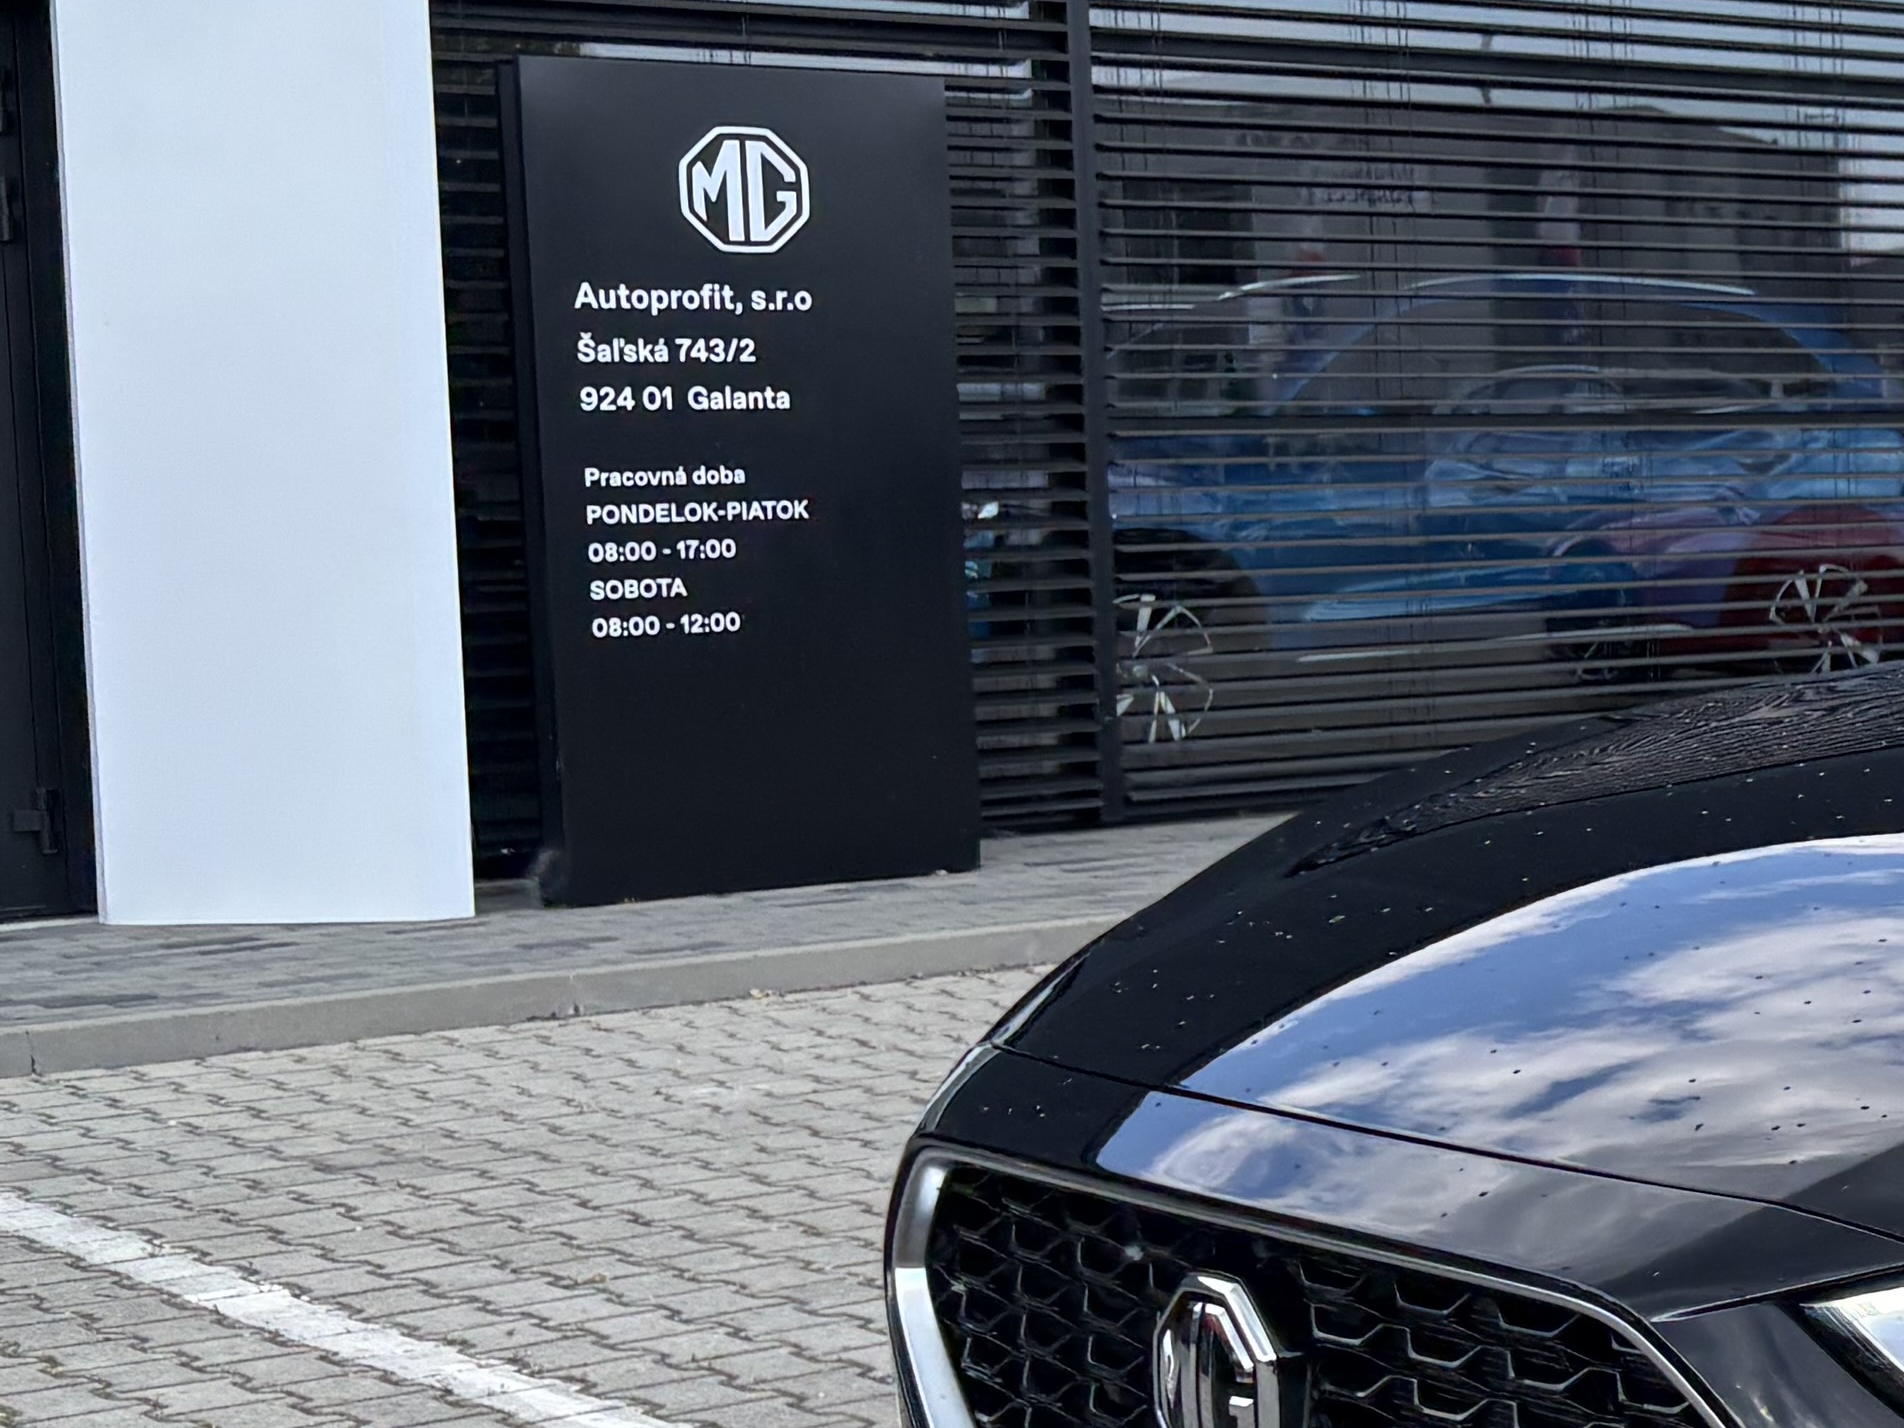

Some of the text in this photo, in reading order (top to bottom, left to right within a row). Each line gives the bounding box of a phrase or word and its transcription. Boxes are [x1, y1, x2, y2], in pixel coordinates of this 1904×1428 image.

[691, 138, 799, 243] MG
[574, 282, 813, 316] Autoprofit, s.r.o
[577, 332, 757, 363] Šaľská 743/2
[579, 385, 791, 411] 924 01 Galanta
[584, 465, 746, 487] Pracovná doba
[586, 499, 810, 525] PONDELOK-PIATOK
[588, 541, 657, 563] 08:00
[676, 539, 737, 560] 17:00
[590, 577, 688, 601] SOBOTA
[592, 615, 661, 638] 08:00
[681, 612, 741, 634] 12:00
